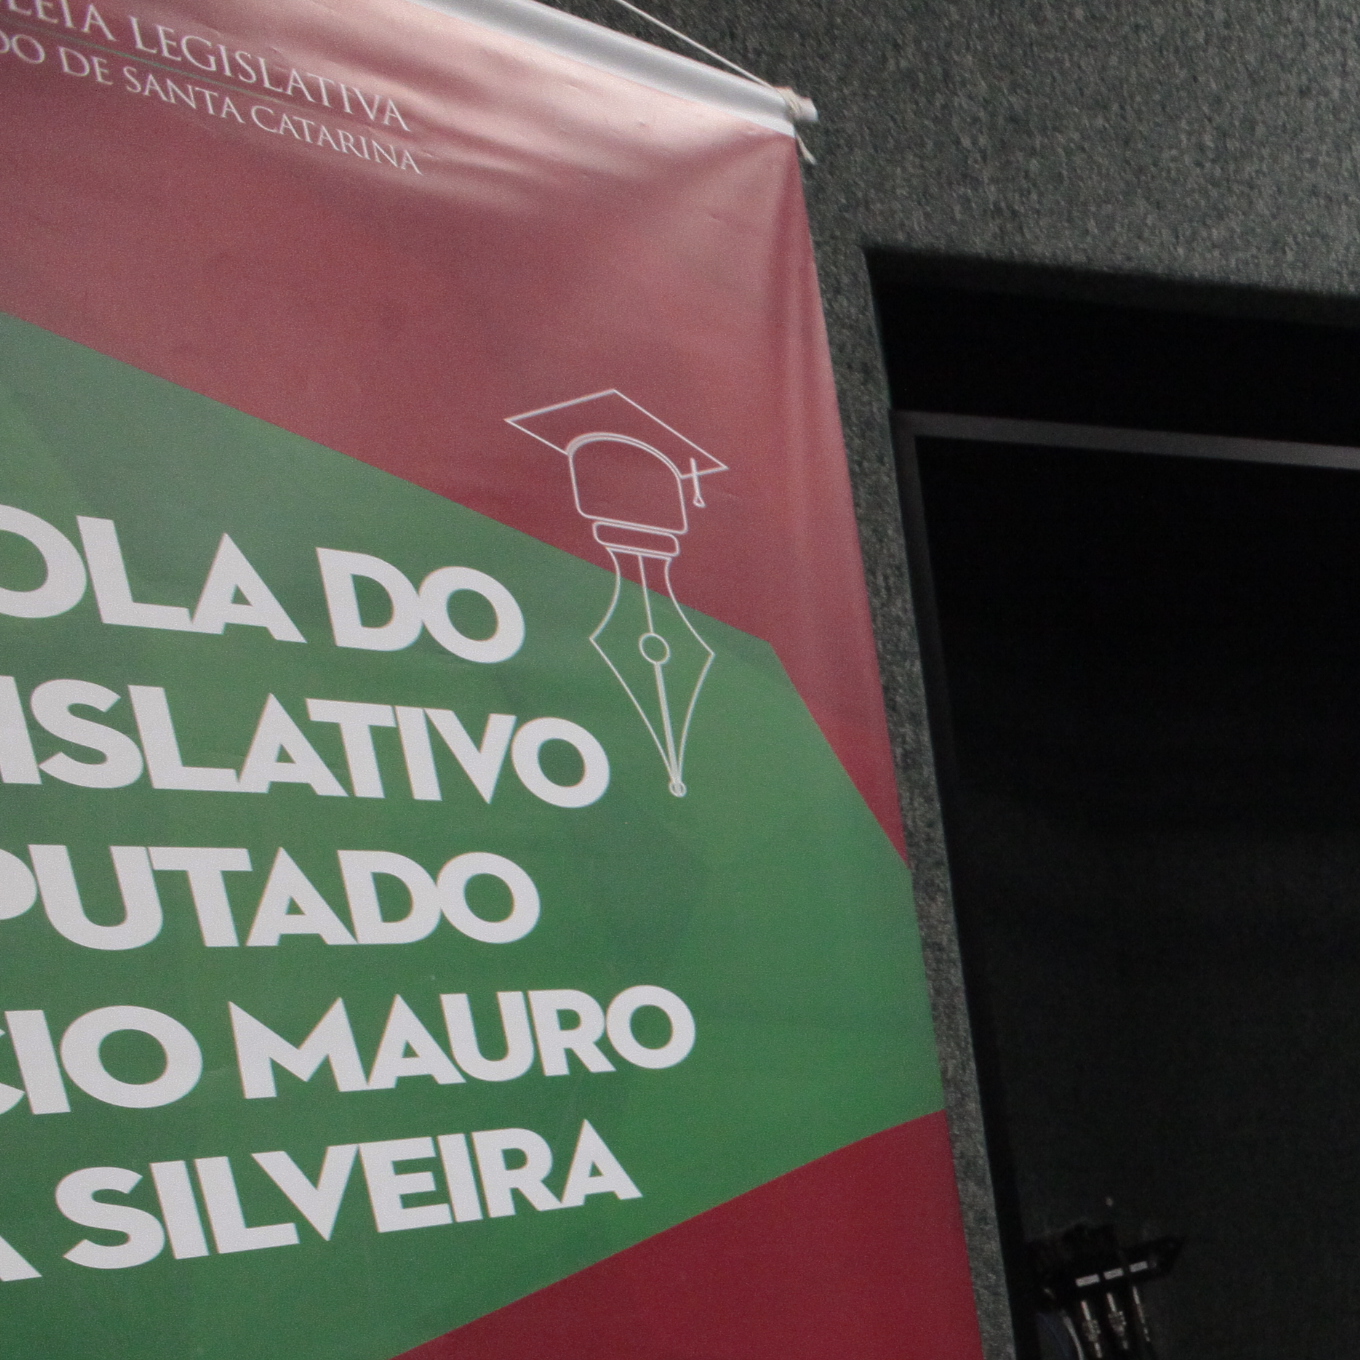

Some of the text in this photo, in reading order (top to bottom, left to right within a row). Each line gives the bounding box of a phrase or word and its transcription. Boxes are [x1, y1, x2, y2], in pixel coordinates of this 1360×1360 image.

[58, 46, 113, 85] DE
[123, 66, 245, 124] SANTA
[250, 104, 423, 175] CATARINA
[129, 15, 411, 132] LEGISLATIVA
[316, 546, 525, 663] DO
[0, 984, 696, 1115] IO MAURO
[55, 1119, 643, 1270] SILVEIRA
